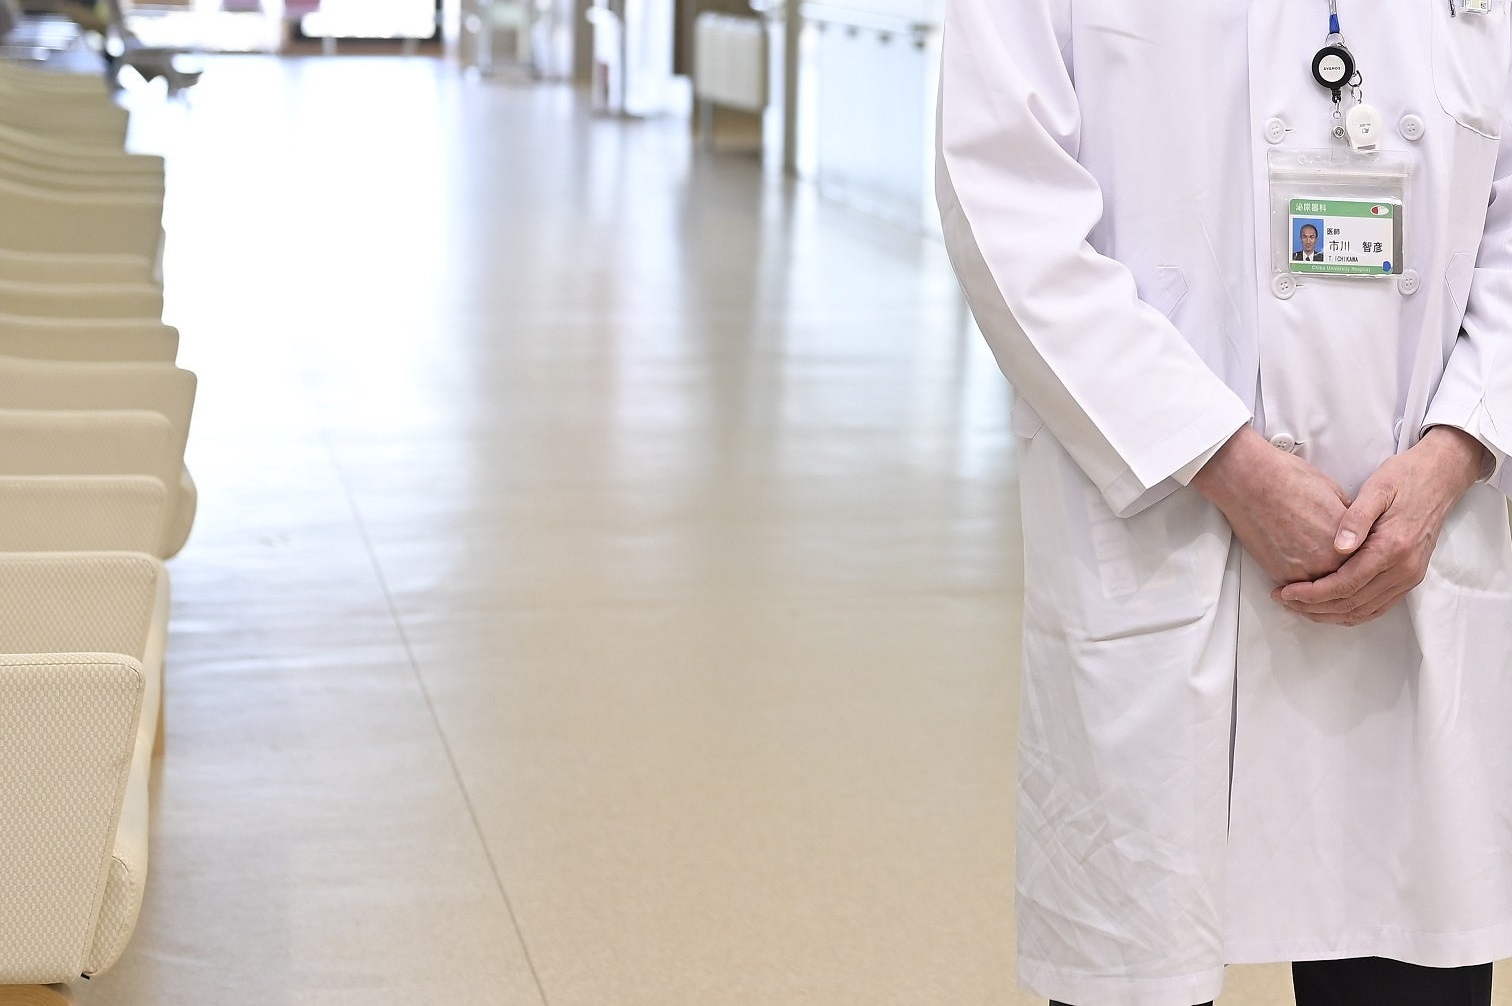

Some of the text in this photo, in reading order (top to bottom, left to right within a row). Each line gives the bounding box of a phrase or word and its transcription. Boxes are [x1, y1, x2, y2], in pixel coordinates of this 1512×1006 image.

[1326, 228, 1341, 236] 医師
[1328, 241, 1384, 254] 市川 智彦
